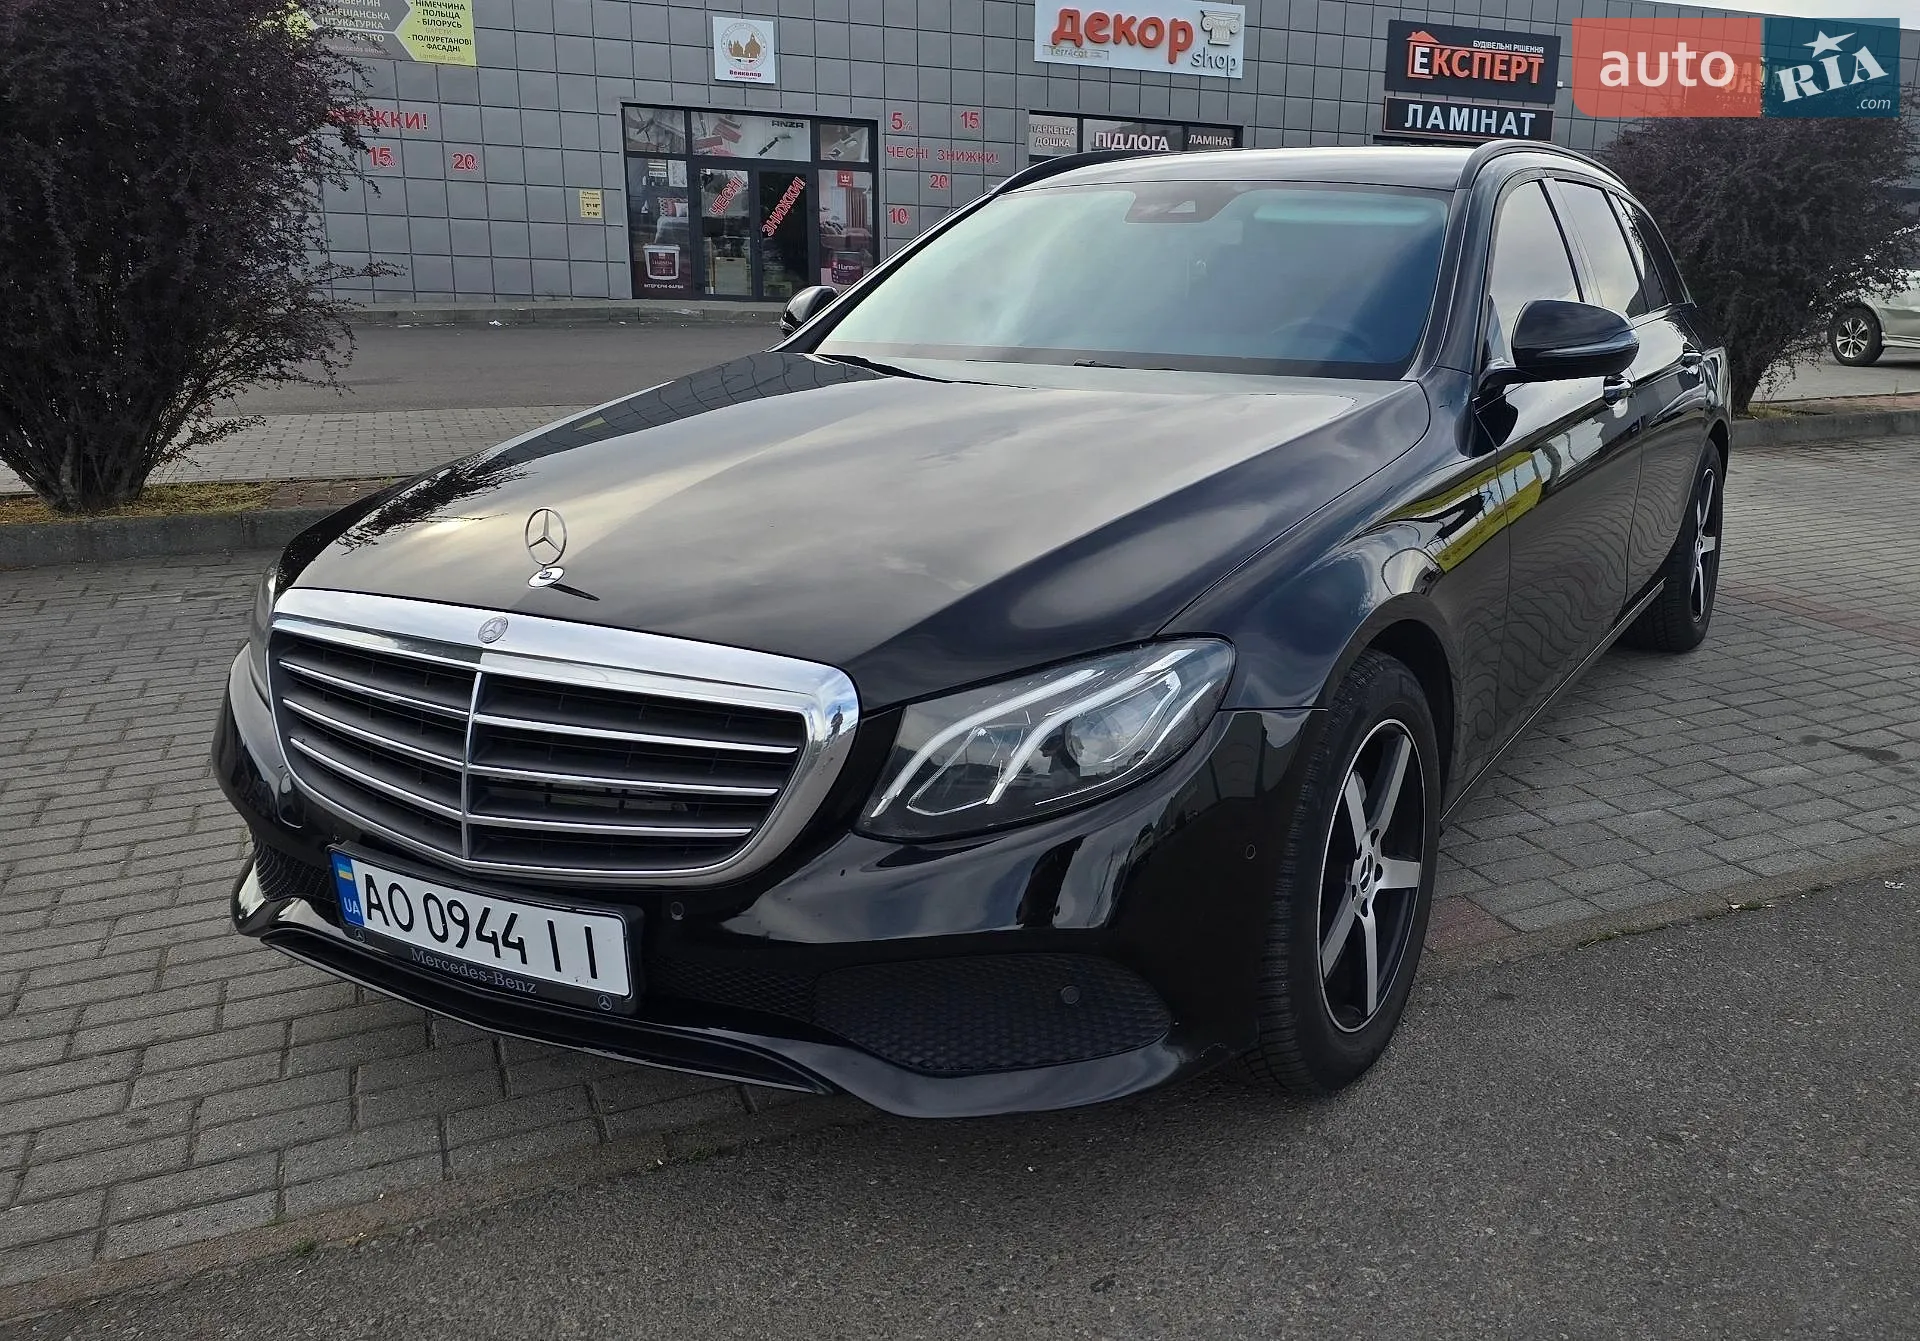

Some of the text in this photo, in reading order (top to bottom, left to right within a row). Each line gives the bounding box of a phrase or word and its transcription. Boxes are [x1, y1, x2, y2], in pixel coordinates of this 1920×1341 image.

[422, 9, 461, 19] ПОЛЬЩА
[422, 19, 462, 28] БІЛОРУСЬ
[412, 34, 472, 46] ПОЛІУРЕТАНОВІ
[426, 43, 461, 52] ФАСАДНІ
[1473, 40, 1544, 54] БУДІВЕЛЬНІ РІШЕННЯ
[1191, 47, 1238, 76] shop
[1413, 46, 1545, 84] ЕКСПЕРТ
[1405, 103, 1536, 136] ЛАМІНАТ
[1035, 136, 1071, 148] ДОШКА
[1095, 131, 1170, 150] ПІДЛОГА
[1188, 134, 1234, 147] ЛАМІНАТ
[886, 146, 1000, 163] ЧЕСНІ ЗНИЖКИ!
[709, 176, 744, 216] ЧЕСНІ
[762, 176, 806, 237] ЗНИЖКИ!
[344, 896, 361, 917] UA
[364, 873, 598, 980] AO 0944 II
[409, 946, 538, 994] Mercedes-Benz
